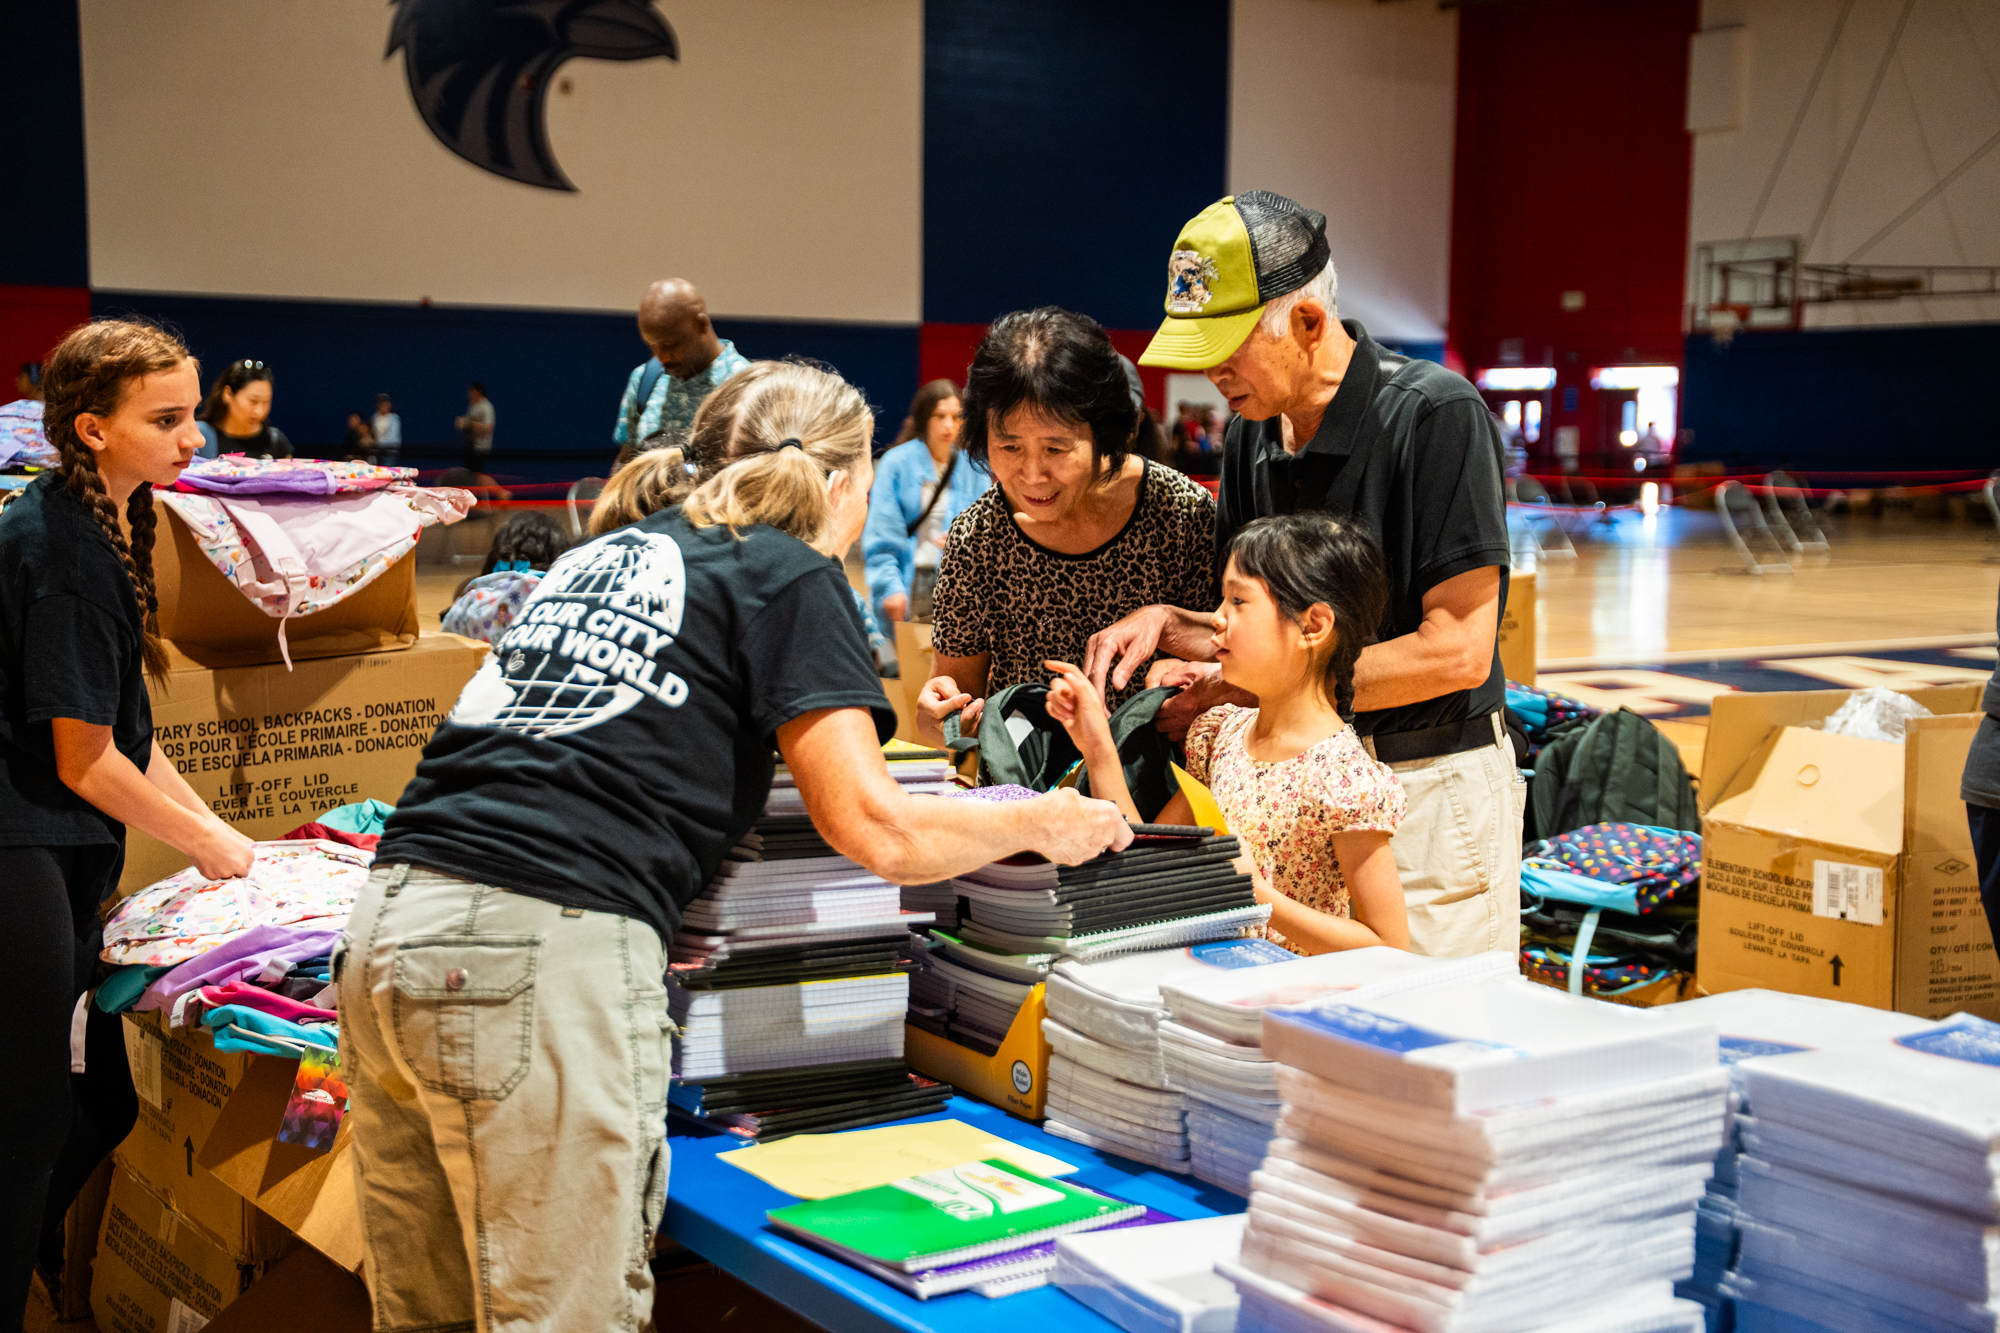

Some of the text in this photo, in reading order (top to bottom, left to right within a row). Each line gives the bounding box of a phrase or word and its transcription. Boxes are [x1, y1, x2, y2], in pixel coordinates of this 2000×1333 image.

[528, 602, 588, 628] OUR
[586, 608, 674, 658] CITY
[506, 624, 561, 651] OUR
[559, 629, 689, 708] WORLD
[197, 718, 259, 737] SCHOOL
[264, 707, 353, 730] BACKPACKS
[365, 698, 435, 718] DONATION
[189, 737, 232, 755] POUR
[301, 722, 368, 742] PRIMAIRE
[177, 759, 197, 774] DE
[202, 751, 271, 772] ESCUELA
[274, 742, 344, 763] PRIMARIA
[356, 729, 428, 753] DONACIÓN
[207, 783, 359, 812] EVER LE COUVERCLE
[220, 773, 329, 797] LIFT-OFF LID
[218, 798, 347, 822] EVANTE LA TAPA
[1707, 858, 1752, 876] ELEMENTARY
[1753, 869, 1782, 884] SCHOOL
[1707, 870, 1724, 882] SACS
[1732, 875, 1747, 887] DOS
[1748, 880, 1769, 893] POUR
[1742, 889, 1751, 900] DE
[1753, 891, 1786, 908] ESCUELA
[1729, 927, 1825, 957] SOULEVER LE COUVERCLE
[1748, 921, 1804, 942] LIFT-OFF LID
[1743, 941, 1811, 964] LEVANTE LA TAPA
[1930, 946, 1947, 955] QTY
[194, 1052, 226, 1081] DONATION
[1015, 1067, 1028, 1078] Wide
[1015, 1075, 1029, 1087] Ruled
